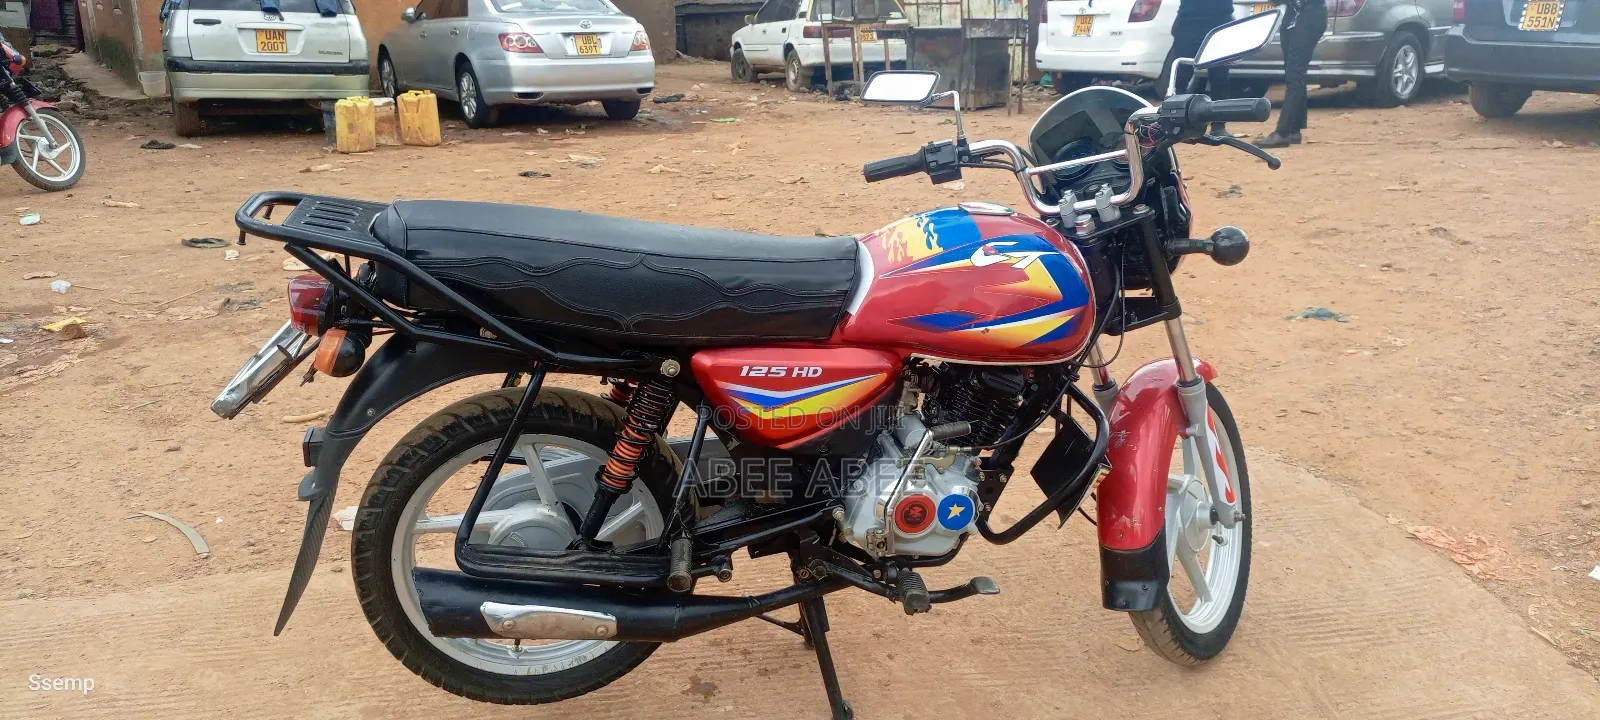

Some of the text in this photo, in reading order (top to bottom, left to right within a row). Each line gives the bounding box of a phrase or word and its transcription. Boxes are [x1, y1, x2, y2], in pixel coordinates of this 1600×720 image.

[1536, 3, 1558, 15] UBB
[1526, 16, 1556, 28] 551N
[265, 29, 285, 40] UAN
[581, 35, 598, 45] UBL
[260, 41, 285, 52] 200T
[579, 45, 598, 54] 639T
[739, 365, 823, 378] 125 HD
